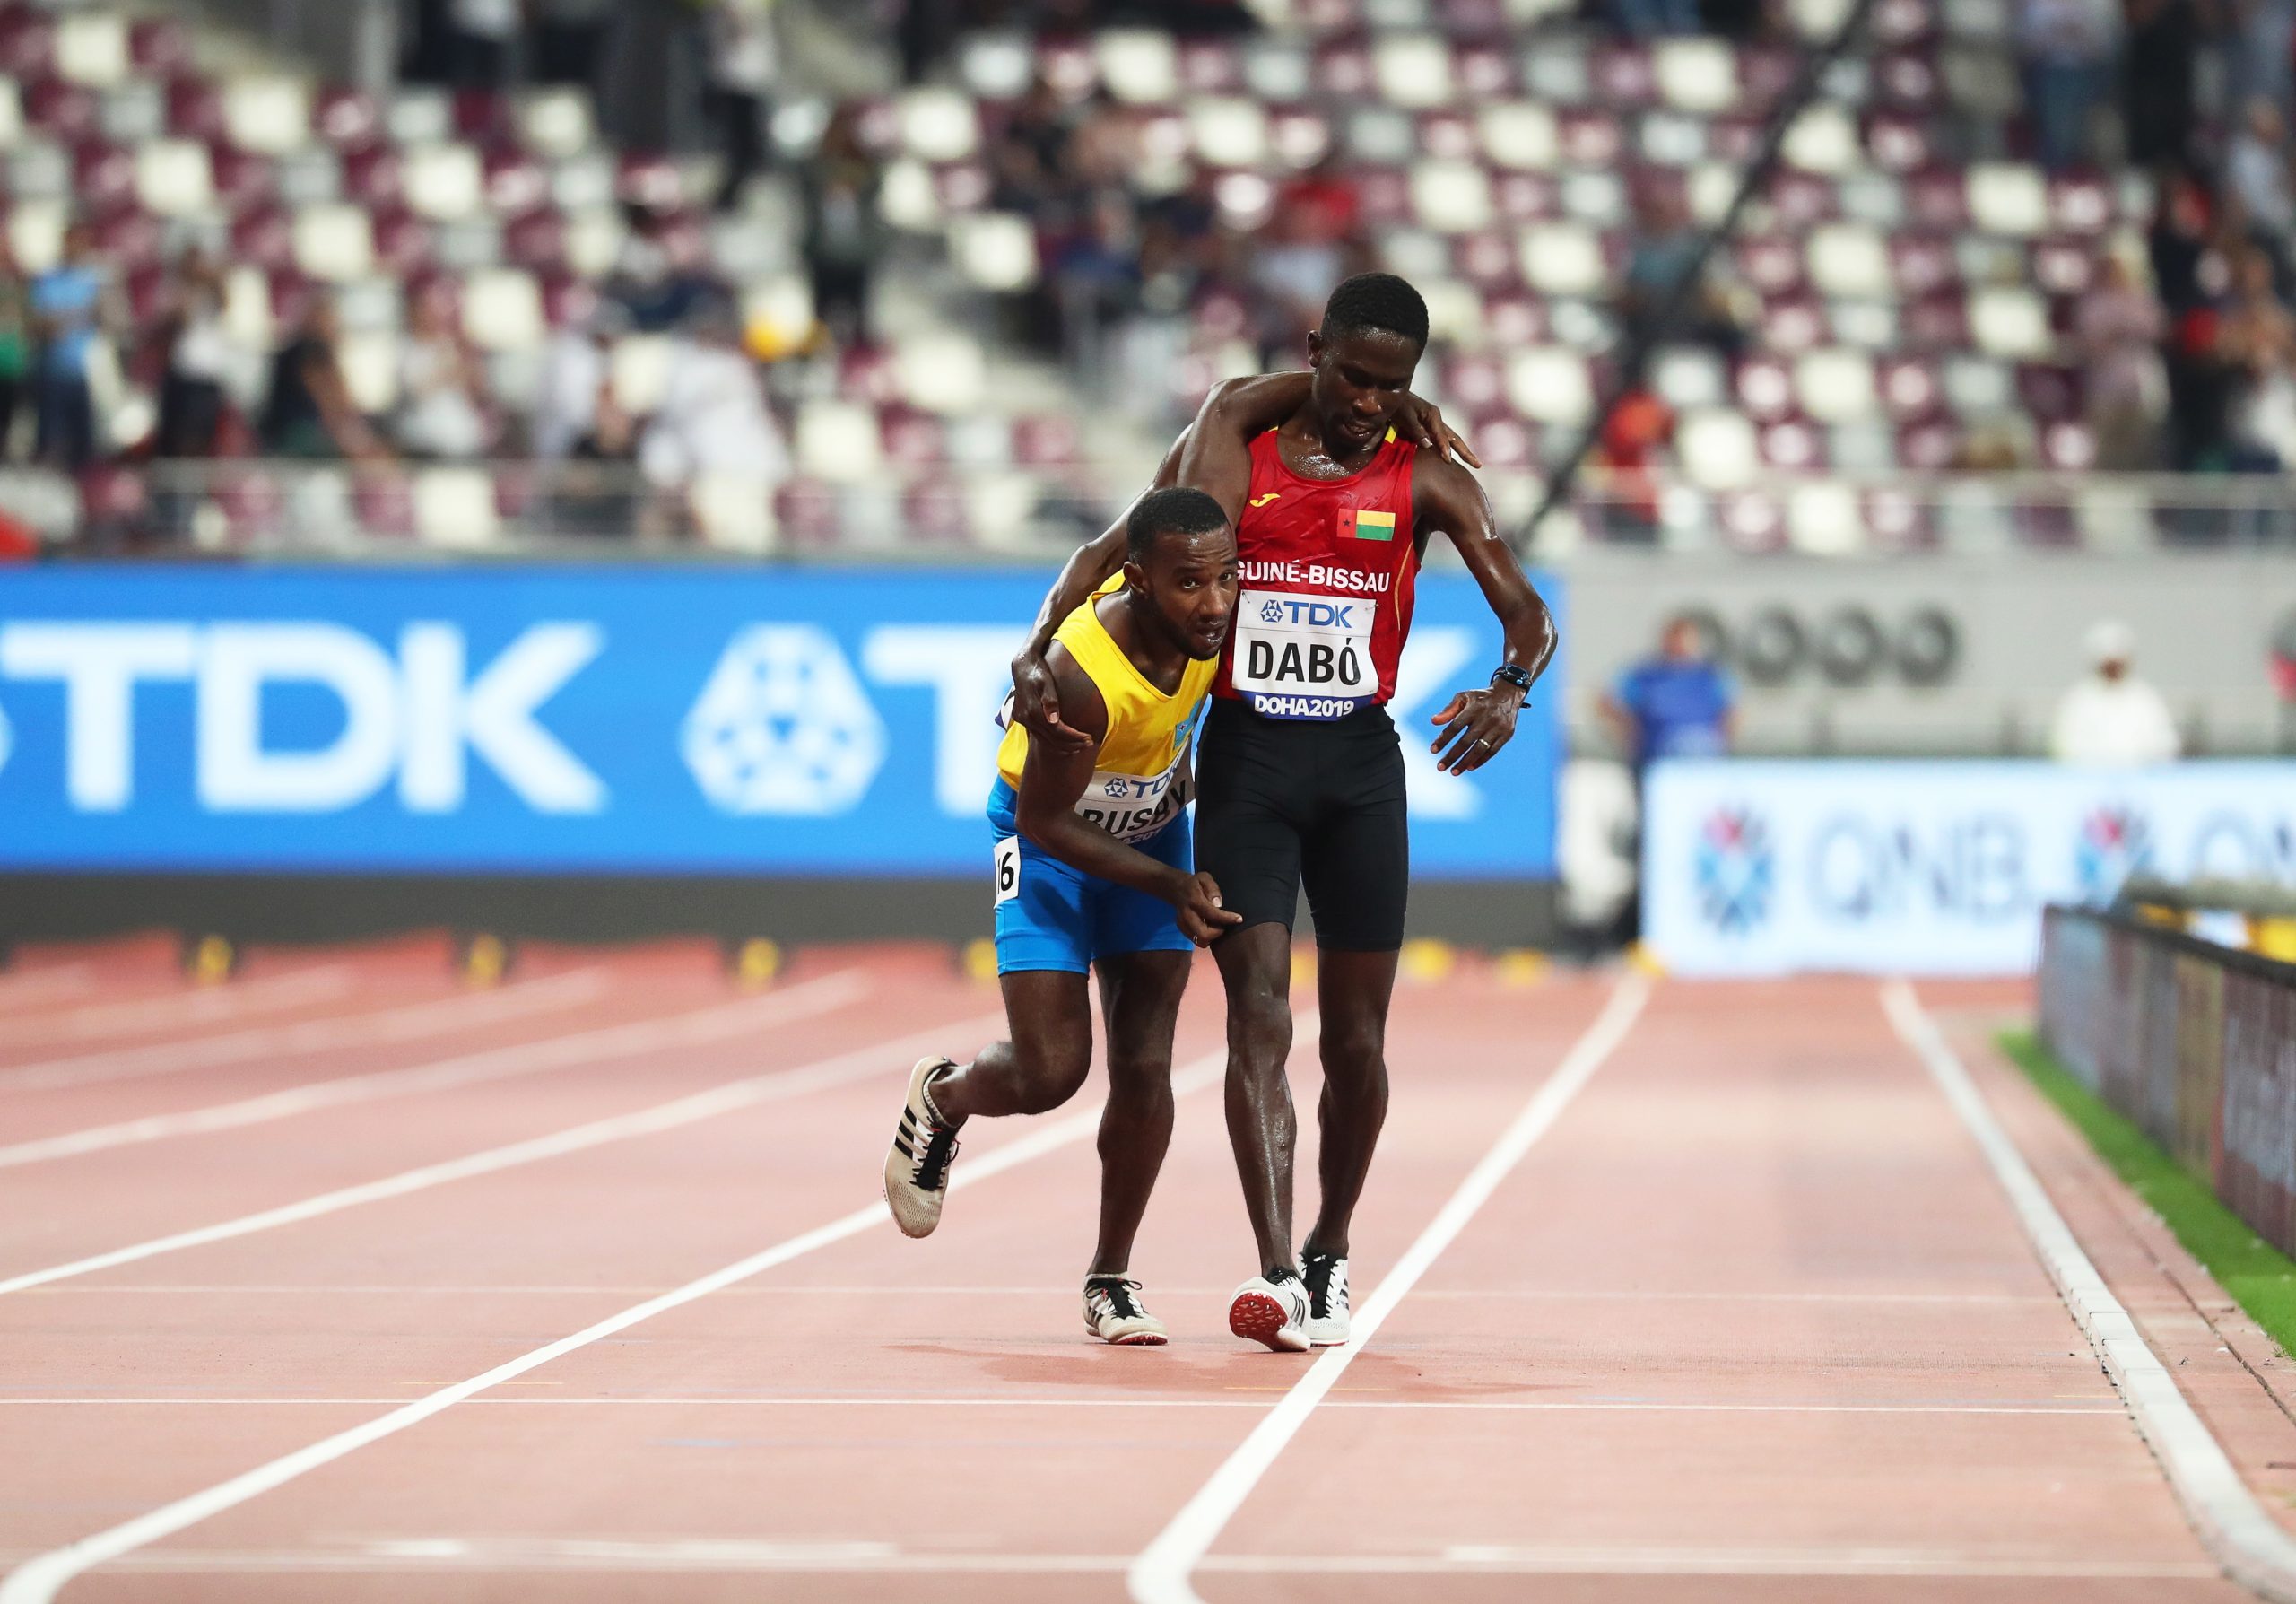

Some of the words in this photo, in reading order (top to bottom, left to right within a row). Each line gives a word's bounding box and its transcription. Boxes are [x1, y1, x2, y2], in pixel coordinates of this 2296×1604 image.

[1237, 560, 1390, 593] GUINÉ-BISSAU
[1283, 600, 1353, 629] TDK
[1248, 638, 1361, 686] DABÓ
[2, 621, 608, 814] TDK
[1254, 695, 1354, 717] DOHA2019
[1083, 780, 1187, 835] BUSBY
